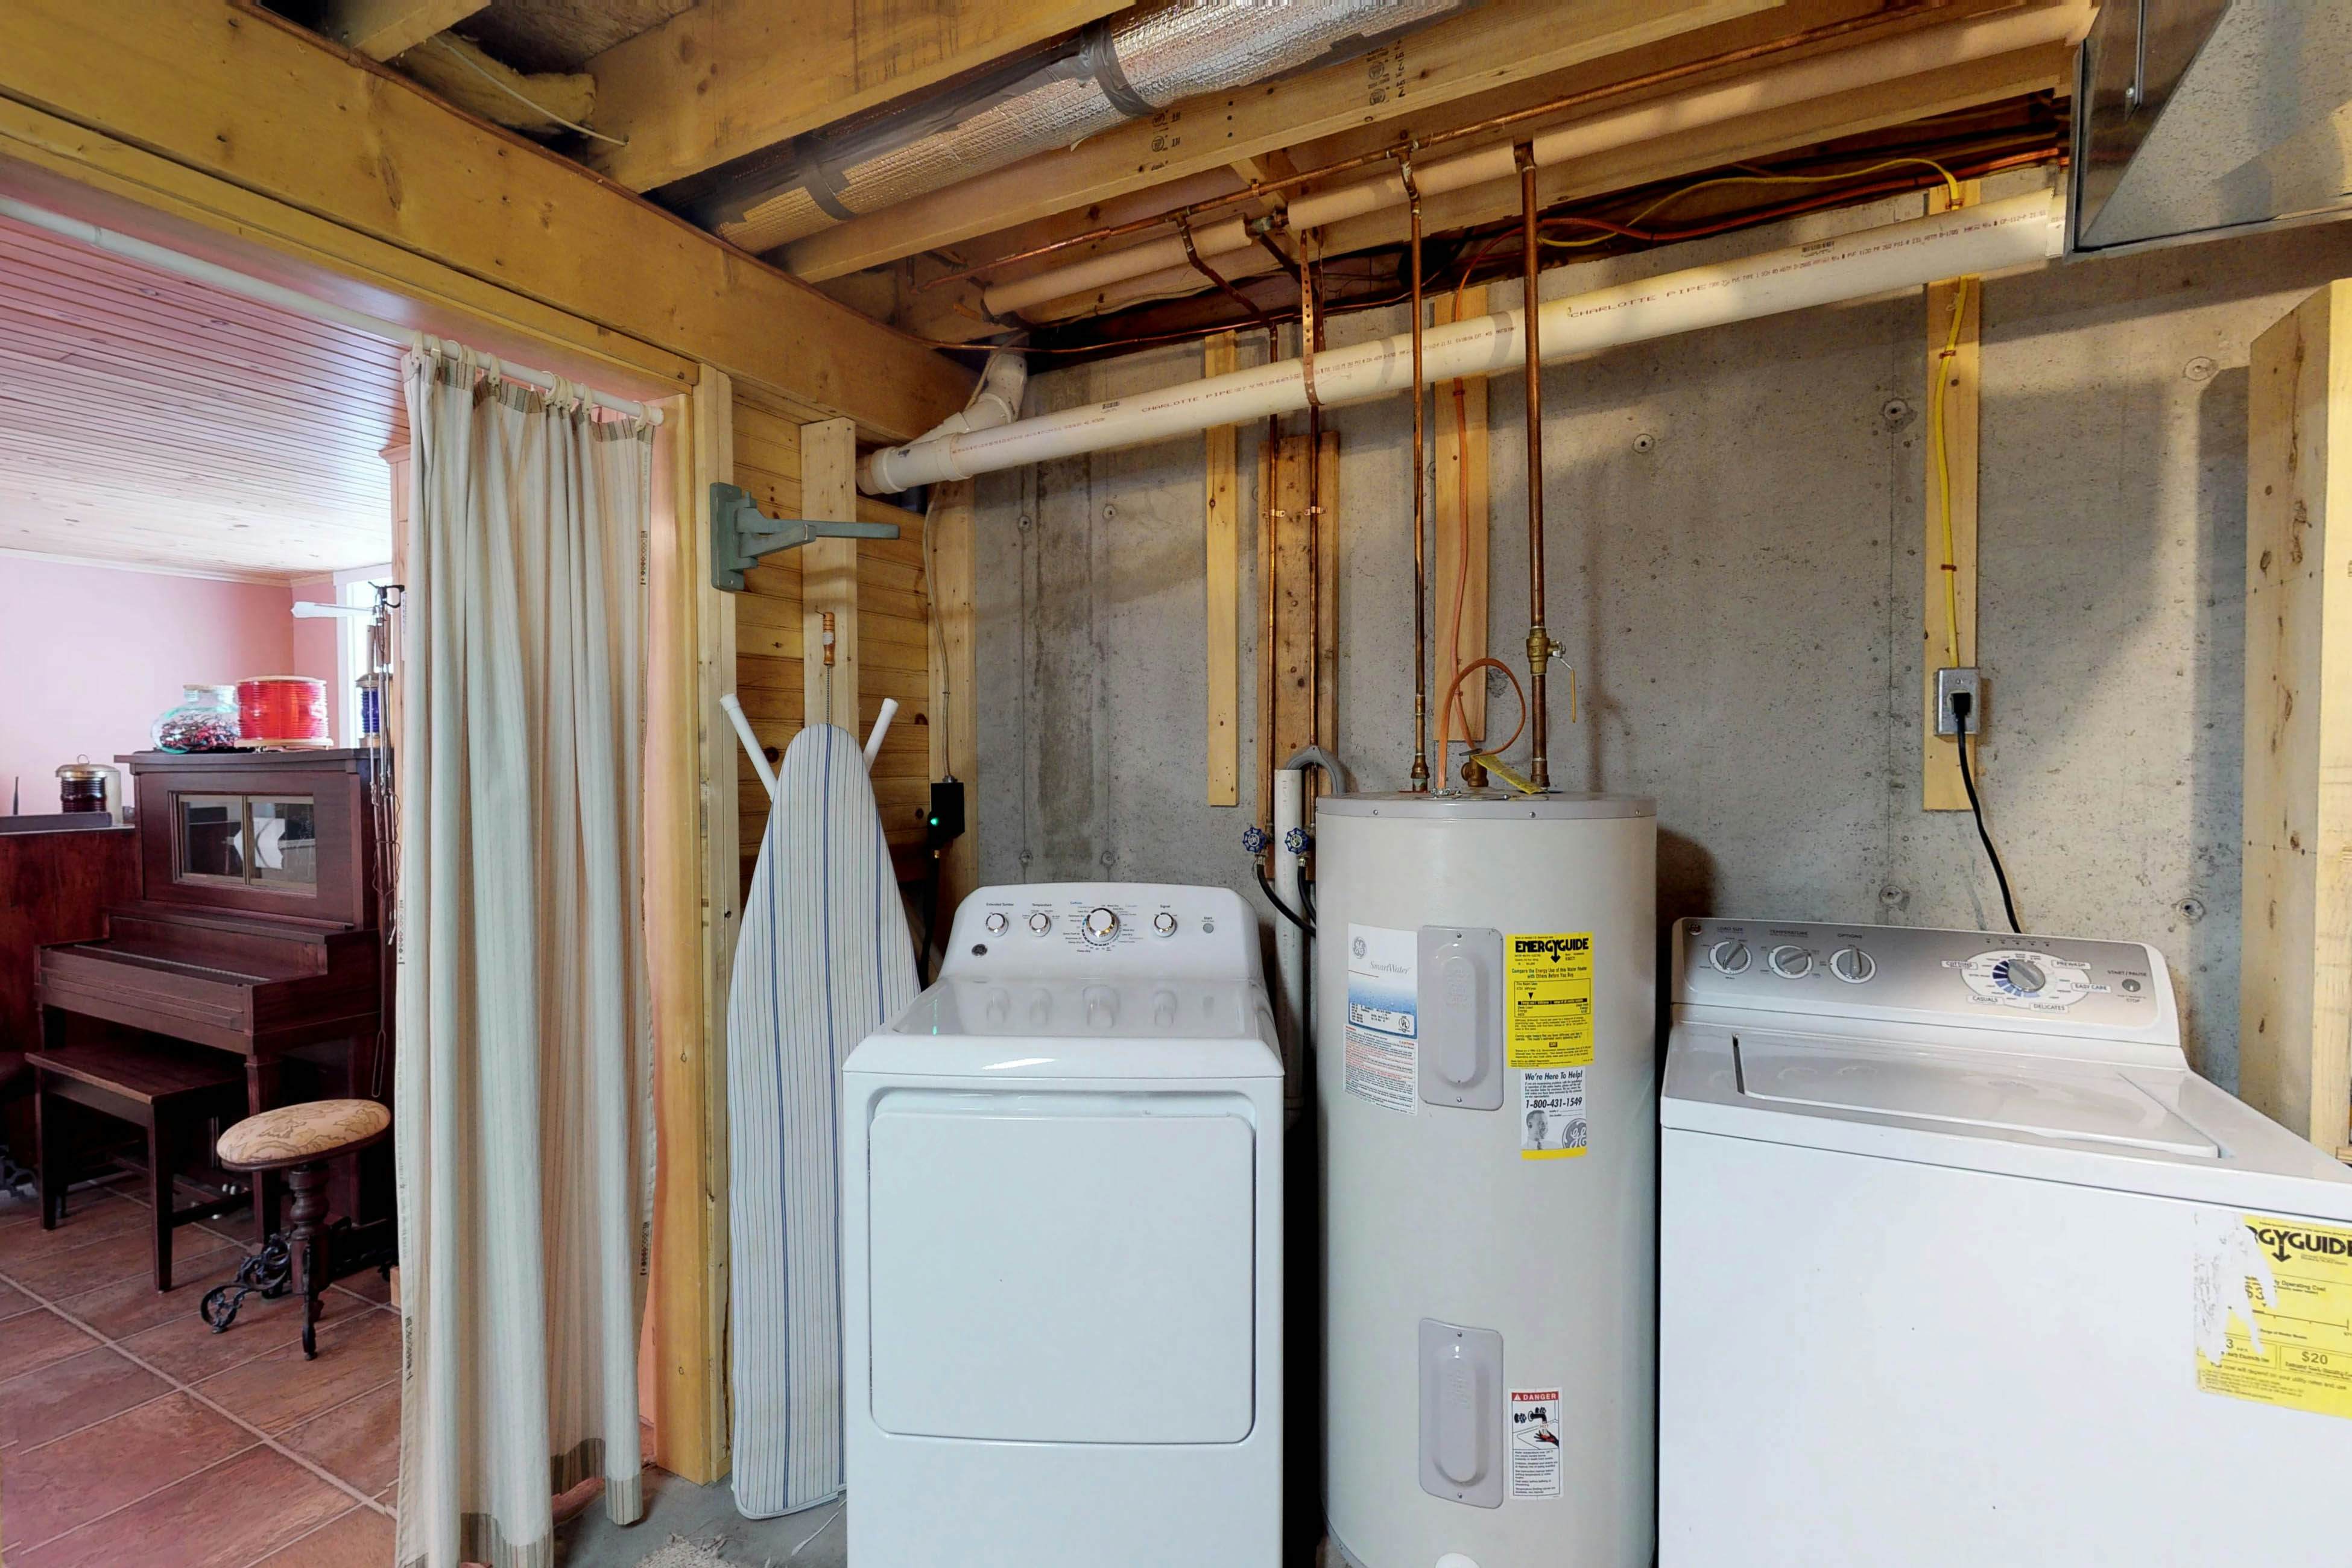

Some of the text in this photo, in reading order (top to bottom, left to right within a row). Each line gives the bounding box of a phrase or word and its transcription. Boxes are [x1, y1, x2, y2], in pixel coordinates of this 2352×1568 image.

[1570, 294, 1657, 318] CHARLOTTE
[1666, 284, 1707, 297] PIPE
[1141, 396, 1200, 413] CHARLOTTE
[1206, 389, 1232, 399] PIPE
[1515, 938, 1589, 953] ENERGYGUIDE
[1370, 961, 1408, 975] SmartWater
[1568, 1070, 1582, 1080] Help!
[1526, 1096, 1582, 1108] 1-800-431-1549
[2281, 1280, 2310, 1290] Operating
[2301, 1351, 2328, 1365] $20
